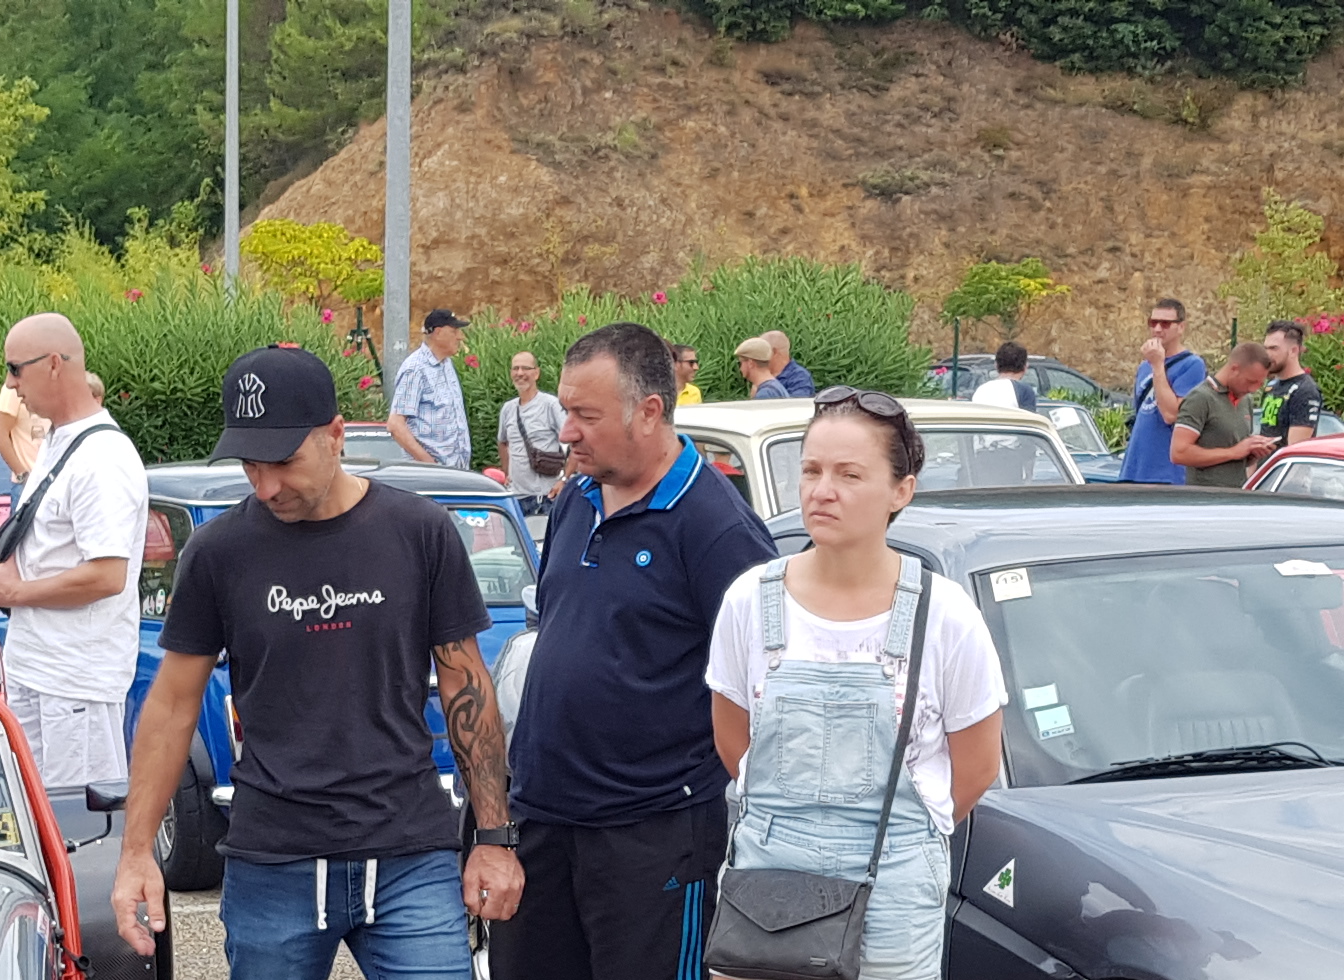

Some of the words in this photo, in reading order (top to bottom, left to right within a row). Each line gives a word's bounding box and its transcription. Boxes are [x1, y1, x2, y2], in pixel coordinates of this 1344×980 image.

[267, 586, 320, 620] Pepe
[320, 584, 385, 618] Jeans
[306, 621, 352, 632] LONDON
